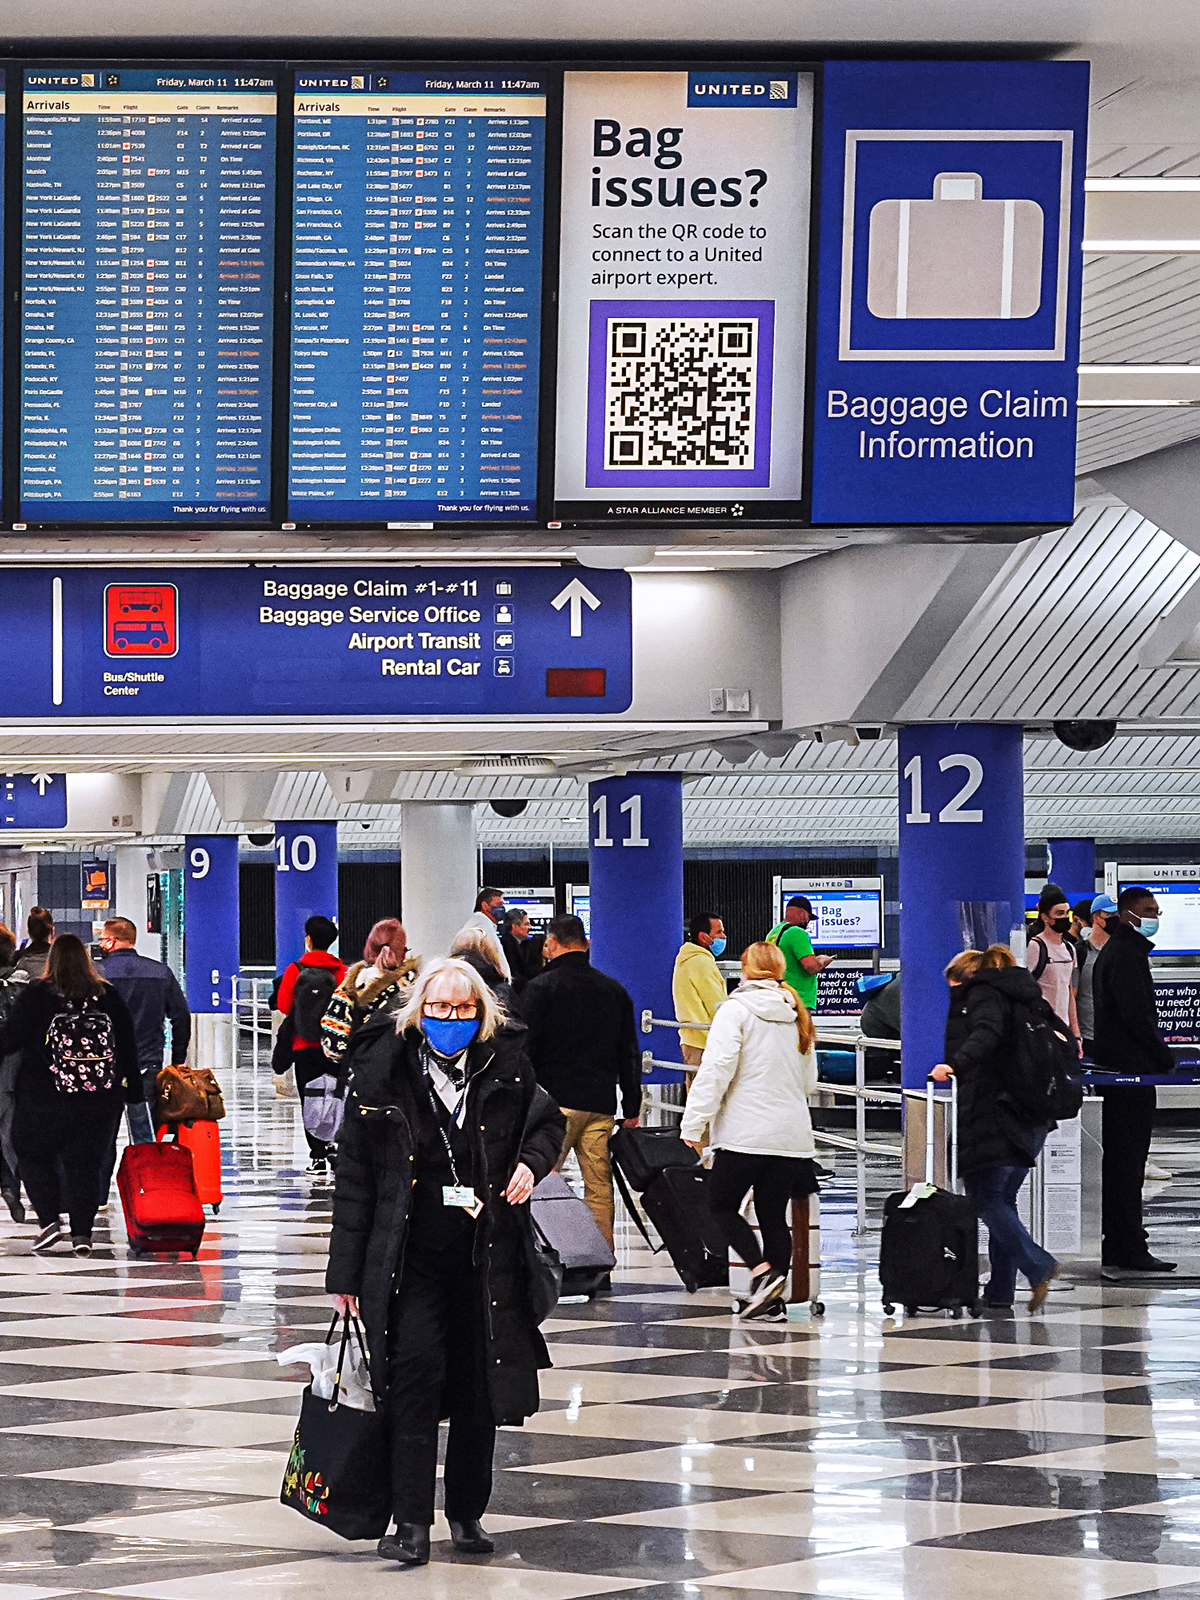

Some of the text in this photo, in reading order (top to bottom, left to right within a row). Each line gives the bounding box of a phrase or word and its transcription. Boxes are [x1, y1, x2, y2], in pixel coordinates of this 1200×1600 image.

[28, 76, 79, 85] UNITED
[156, 78, 227, 87] Friday, March 11
[234, 78, 274, 87] 11:47am
[299, 79, 349, 87] UNITED
[425, 80, 494, 90] Friday, March 11
[501, 80, 540, 89] 11:47am
[694, 85, 765, 96] UNITED
[27, 100, 70, 111] Arrivals
[297, 102, 340, 113] Arrivals
[593, 118, 684, 169] Bag
[590, 167, 768, 208] issues?
[592, 223, 767, 242] Scan the QR code to
[591, 246, 763, 262] connect to a United
[591, 270, 718, 289] airport expert.
[827, 389, 1069, 425] Baggage Claim
[859, 430, 1034, 459] Information
[438, 504, 458, 512] Thank
[484, 504, 504, 513] flying
[504, 504, 520, 512] with
[263, 580, 478, 600] Baggage Claim #1-#11
[259, 606, 481, 627] Baggage Service Office
[349, 632, 481, 653] Airport Transit
[381, 658, 481, 676] Rental Car
[103, 672, 165, 682] Bus/Shuttle
[103, 685, 140, 696] Center
[903, 753, 984, 824] 12
[592, 794, 650, 848] 11
[276, 834, 317, 872] 10
[190, 847, 210, 879] 9
[821, 905, 842, 917] Bag
[821, 916, 861, 926] issues?
[828, 970, 864, 979] who asks
[820, 979, 841, 987] need
[1177, 988, 1197, 996] who
[826, 997, 842, 1006] you
[1167, 996, 1191, 1006] need
[1156, 1007, 1195, 1018] houldn't
[1175, 1020, 1193, 1030] you
